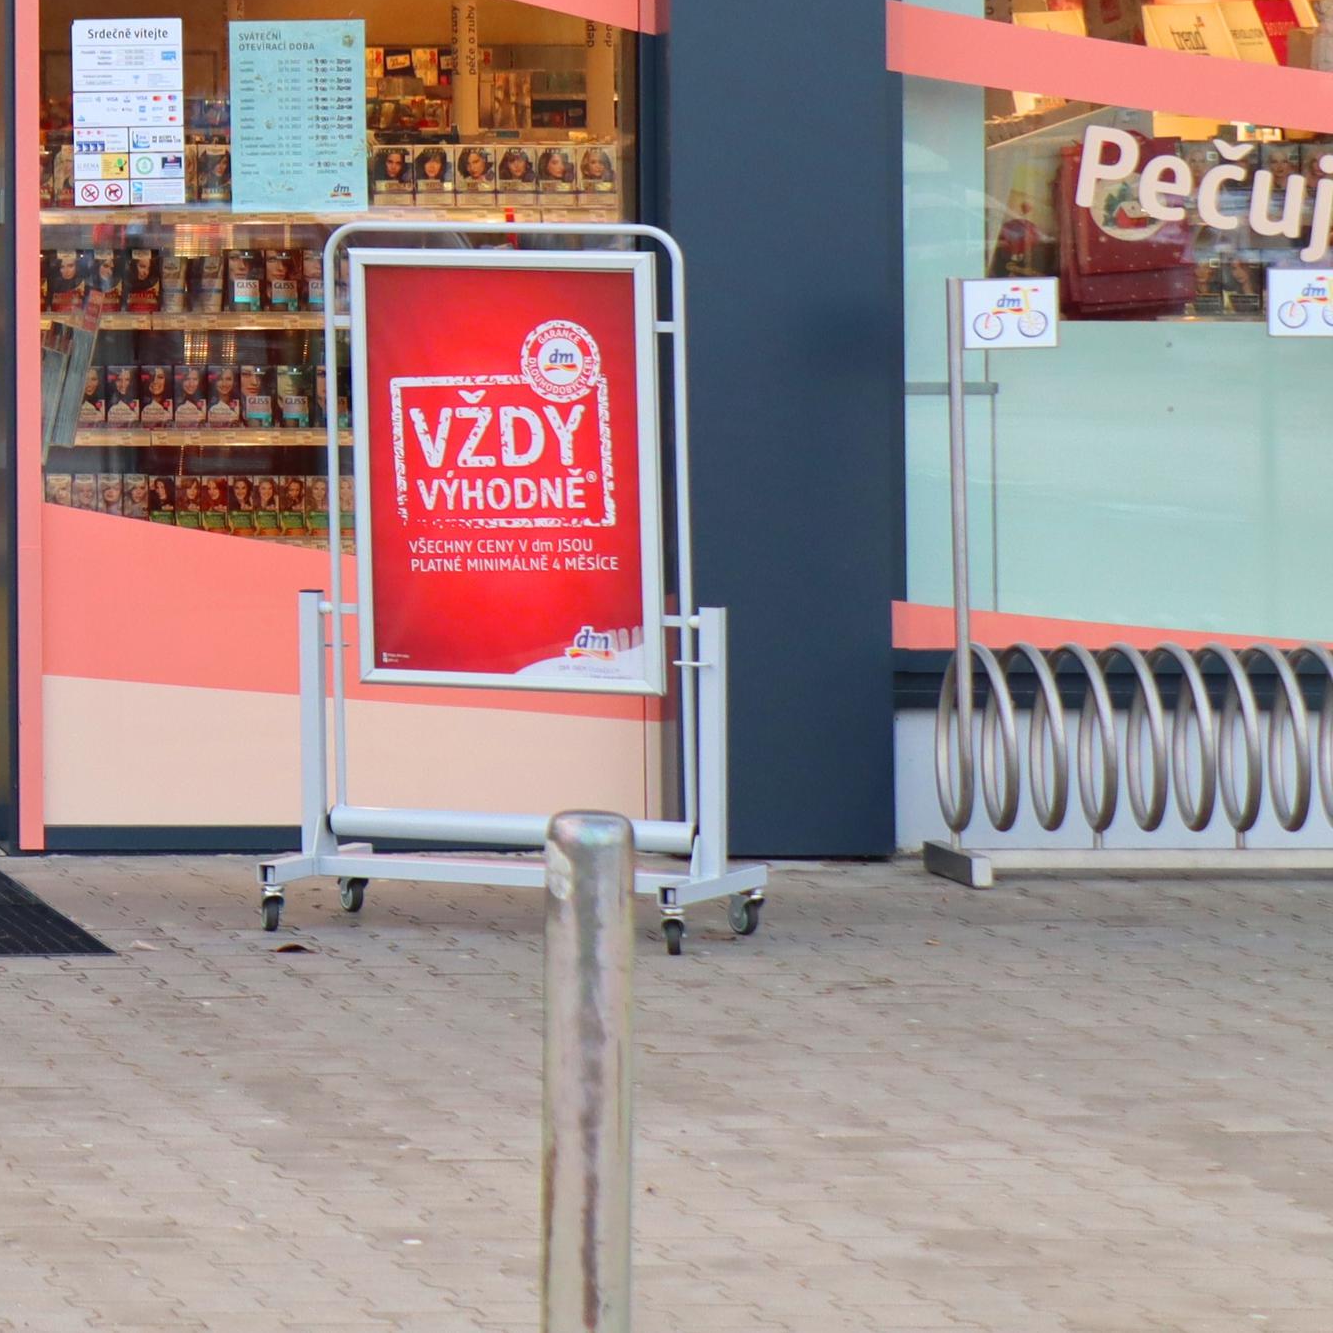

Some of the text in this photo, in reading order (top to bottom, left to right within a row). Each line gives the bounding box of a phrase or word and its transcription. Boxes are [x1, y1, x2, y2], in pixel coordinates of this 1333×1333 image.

[87, 28, 169, 40] Srdečně vítejte
[238, 30, 282, 41] SVÁTEČNÍ
[238, 42, 315, 52] OTEVÍRACÍ DOBA
[333, 183, 350, 193] dm
[1075, 124, 1333, 263] Pečuj
[1302, 283, 1326, 297] dm
[996, 294, 1022, 308] dm
[537, 329, 582, 345] GARANCE
[548, 348, 574, 364] dm
[409, 389, 585, 468] VŽDY
[409, 537, 593, 555] VŠECHNY CENY V dm JSOU
[411, 553, 619, 572] PLATNÉ MINIMÁLNĚ 4 MĚSÍCE
[576, 628, 610, 649] dm
